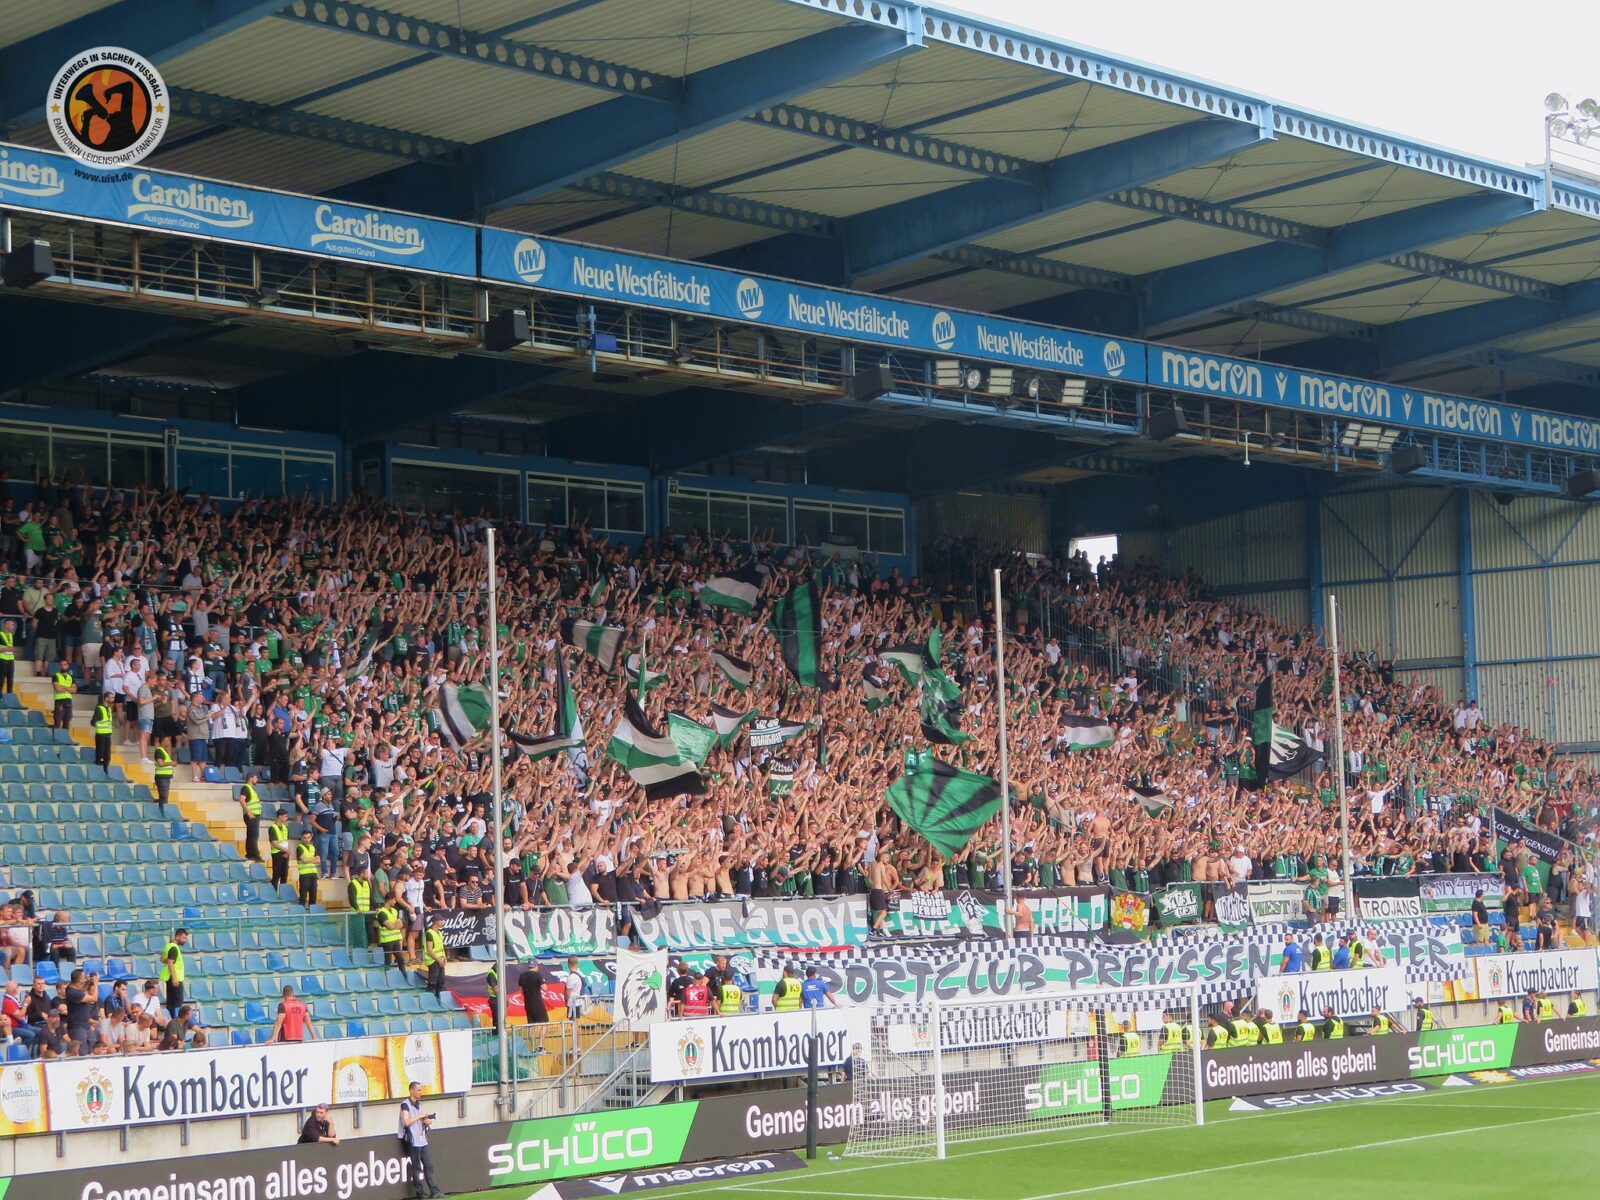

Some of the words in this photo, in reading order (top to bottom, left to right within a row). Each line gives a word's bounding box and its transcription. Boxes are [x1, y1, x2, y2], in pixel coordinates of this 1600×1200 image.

[132, 173, 249, 219] Carolinen
[144, 213, 157, 222] Aus
[158, 216, 180, 226] gutem
[180, 218, 200, 230] Grund
[315, 204, 421, 246] Carolinen
[325, 242, 336, 251] Aus
[337, 244, 356, 254] gutem
[356, 247, 376, 257] Grund
[518, 248, 542, 272] NW
[573, 256, 614, 291] Neue
[615, 263, 711, 306] Westfälische
[739, 286, 762, 309] NW
[788, 293, 825, 326] Neue
[826, 299, 910, 339] Westfälische
[934, 319, 955, 342] NW
[977, 323, 1010, 354] Neue
[1010, 330, 1084, 367] Westfälische
[1105, 347, 1124, 370] NW
[1162, 350, 1262, 399] macron
[1300, 375, 1391, 418] macron
[1423, 396, 1502, 436] macron
[1531, 413, 1600, 450] macron
[1433, 877, 1501, 897] MYTHOS
[1363, 900, 1419, 917] TROJANS
[441, 929, 480, 947] ünster
[790, 983, 800, 993] K9
[1506, 957, 1579, 994] Krombacher
[726, 990, 739, 1000] K9
[1299, 975, 1389, 1018] Krombacher
[1206, 1056, 1293, 1087] Gemeinsam
[1296, 1050, 1328, 1078] alles
[1331, 1045, 1377, 1081] geben!
[1407, 1034, 1496, 1070] SCHÜCO
[122, 1054, 309, 1120] Krombacher
[1263, 1083, 1425, 1108] SCHÜCO
[488, 1120, 653, 1177] SCHÜCO
[265, 1160, 328, 1195] alles
[633, 1158, 776, 1188] macron
